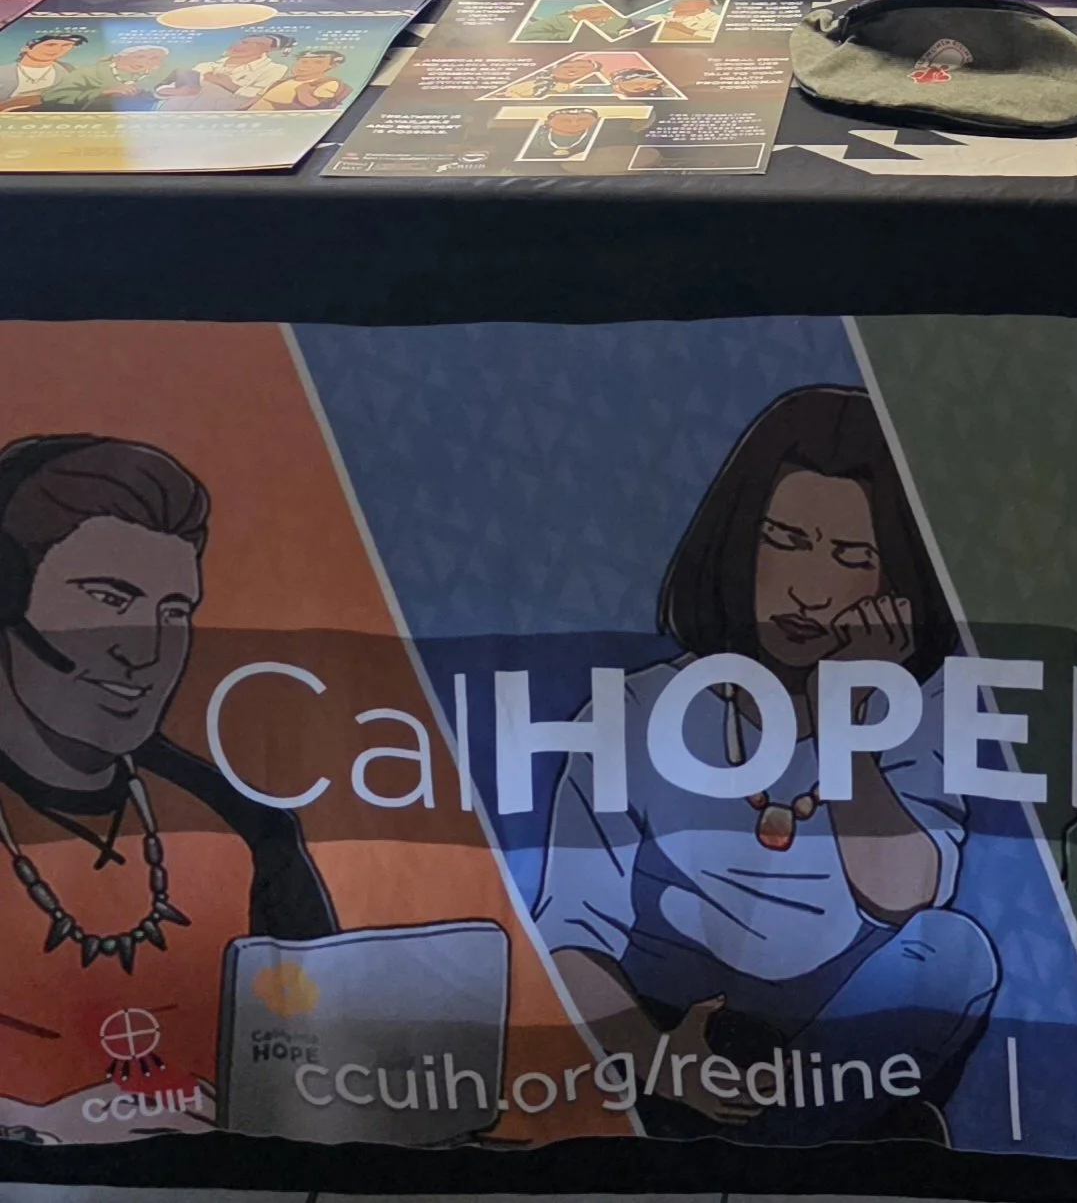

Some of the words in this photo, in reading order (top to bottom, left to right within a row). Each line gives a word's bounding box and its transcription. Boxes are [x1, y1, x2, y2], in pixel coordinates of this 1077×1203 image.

[252, 1042, 320, 1065] HOPE
[294, 1035, 923, 1115] ccuih.org/redline
[82, 1085, 204, 1123] CCUIH
